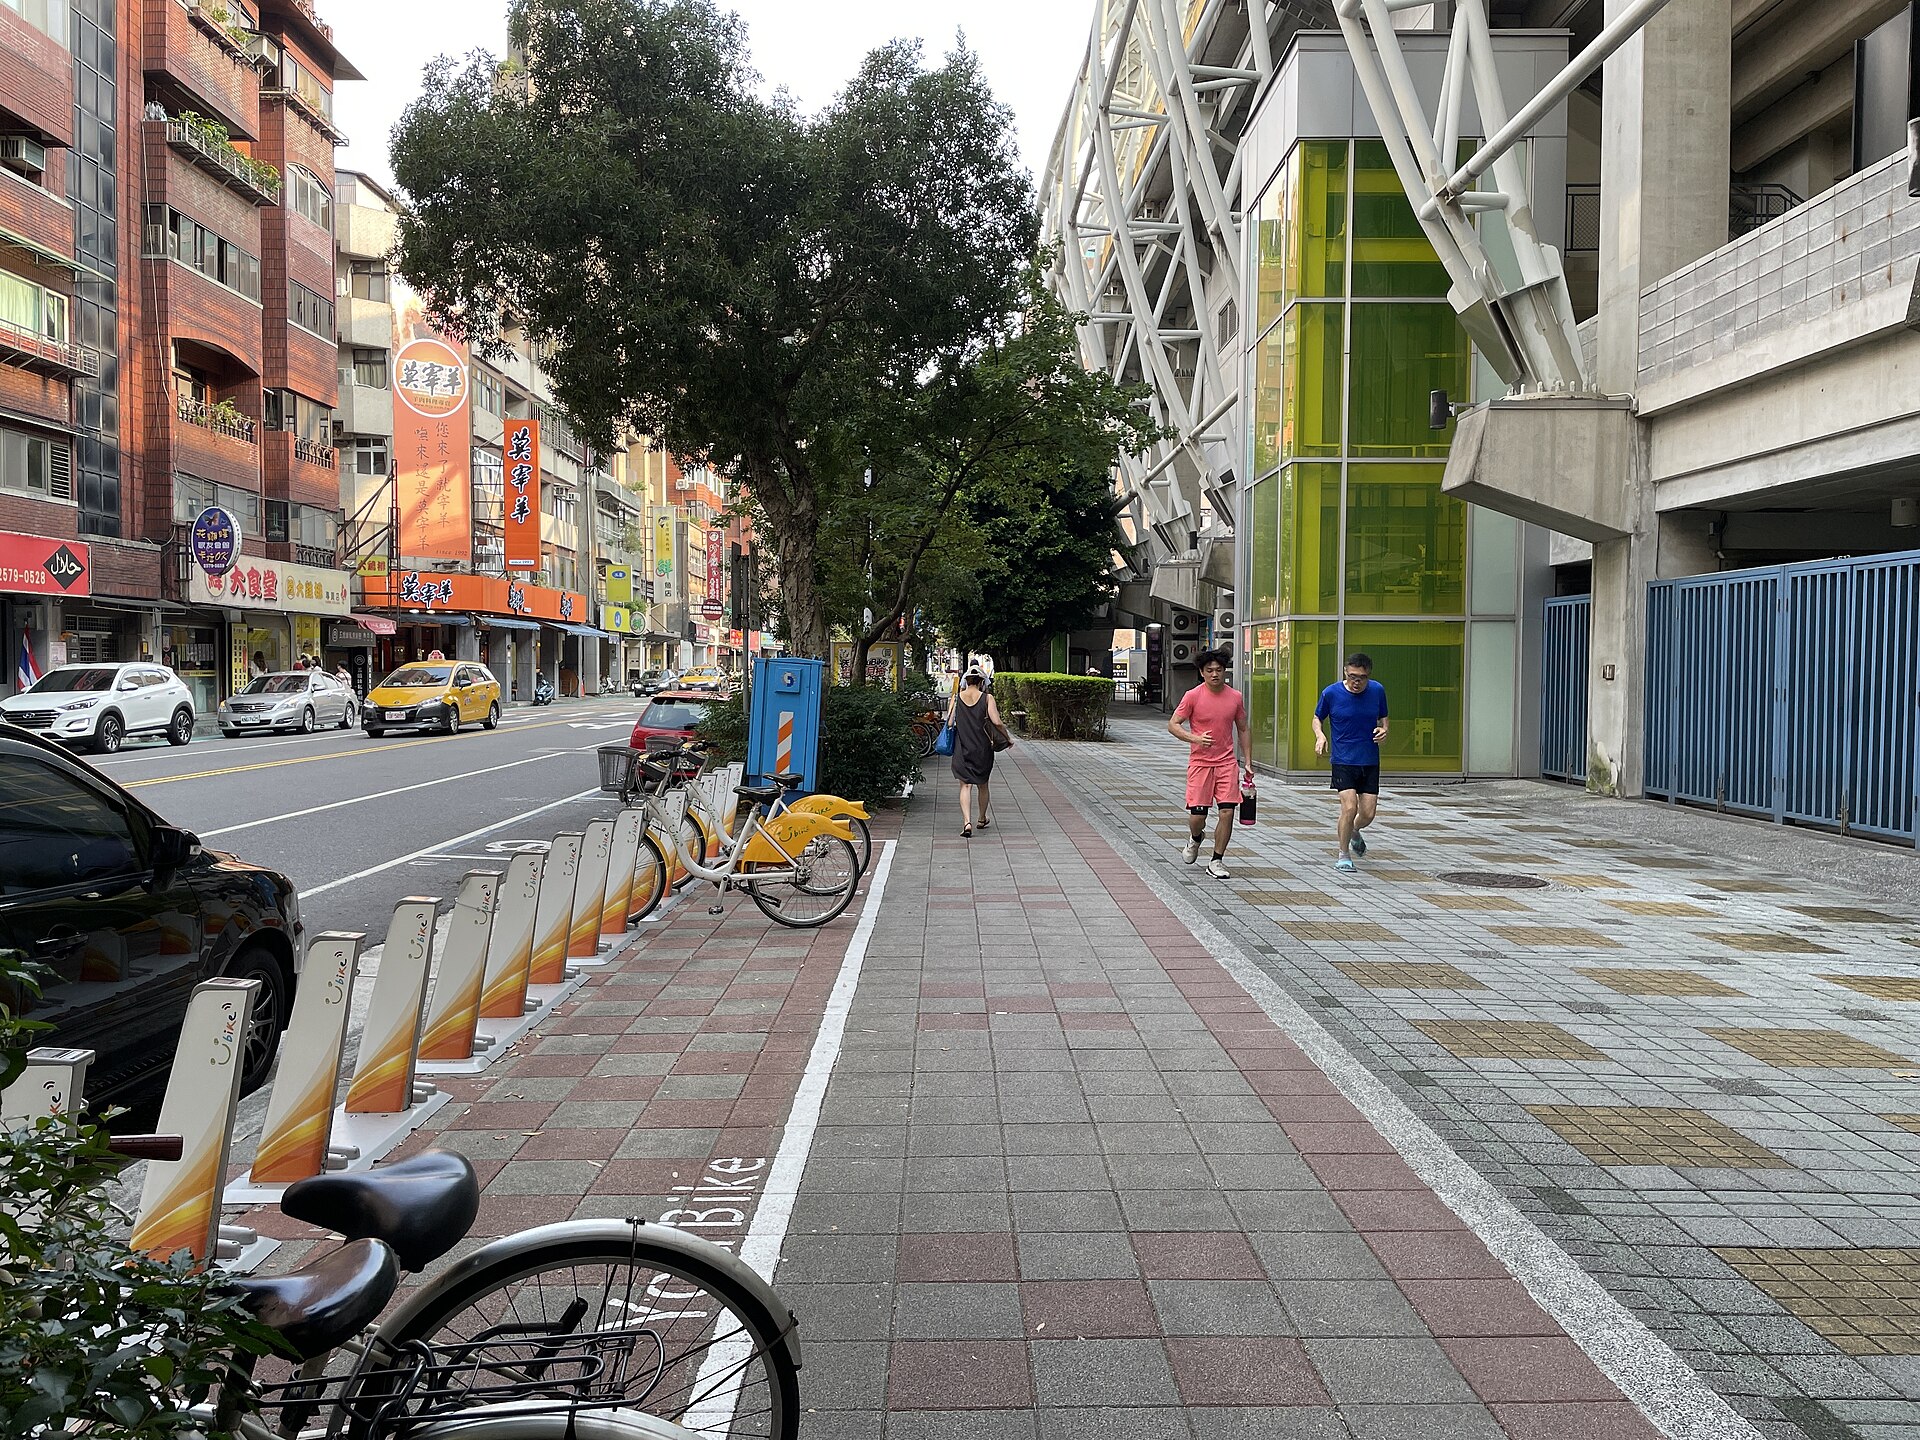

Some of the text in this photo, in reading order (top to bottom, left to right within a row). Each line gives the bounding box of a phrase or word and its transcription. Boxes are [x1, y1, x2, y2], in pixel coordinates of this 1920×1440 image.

[400, 361, 462, 396] 莫宰羊
[435, 421, 452, 529] 您來了就宰羊
[507, 427, 533, 524] 莫宰羊
[50, 552, 82, 576] حلال
[230, 565, 278, 600] 大食堂
[400, 571, 454, 609] 莫宰羊
